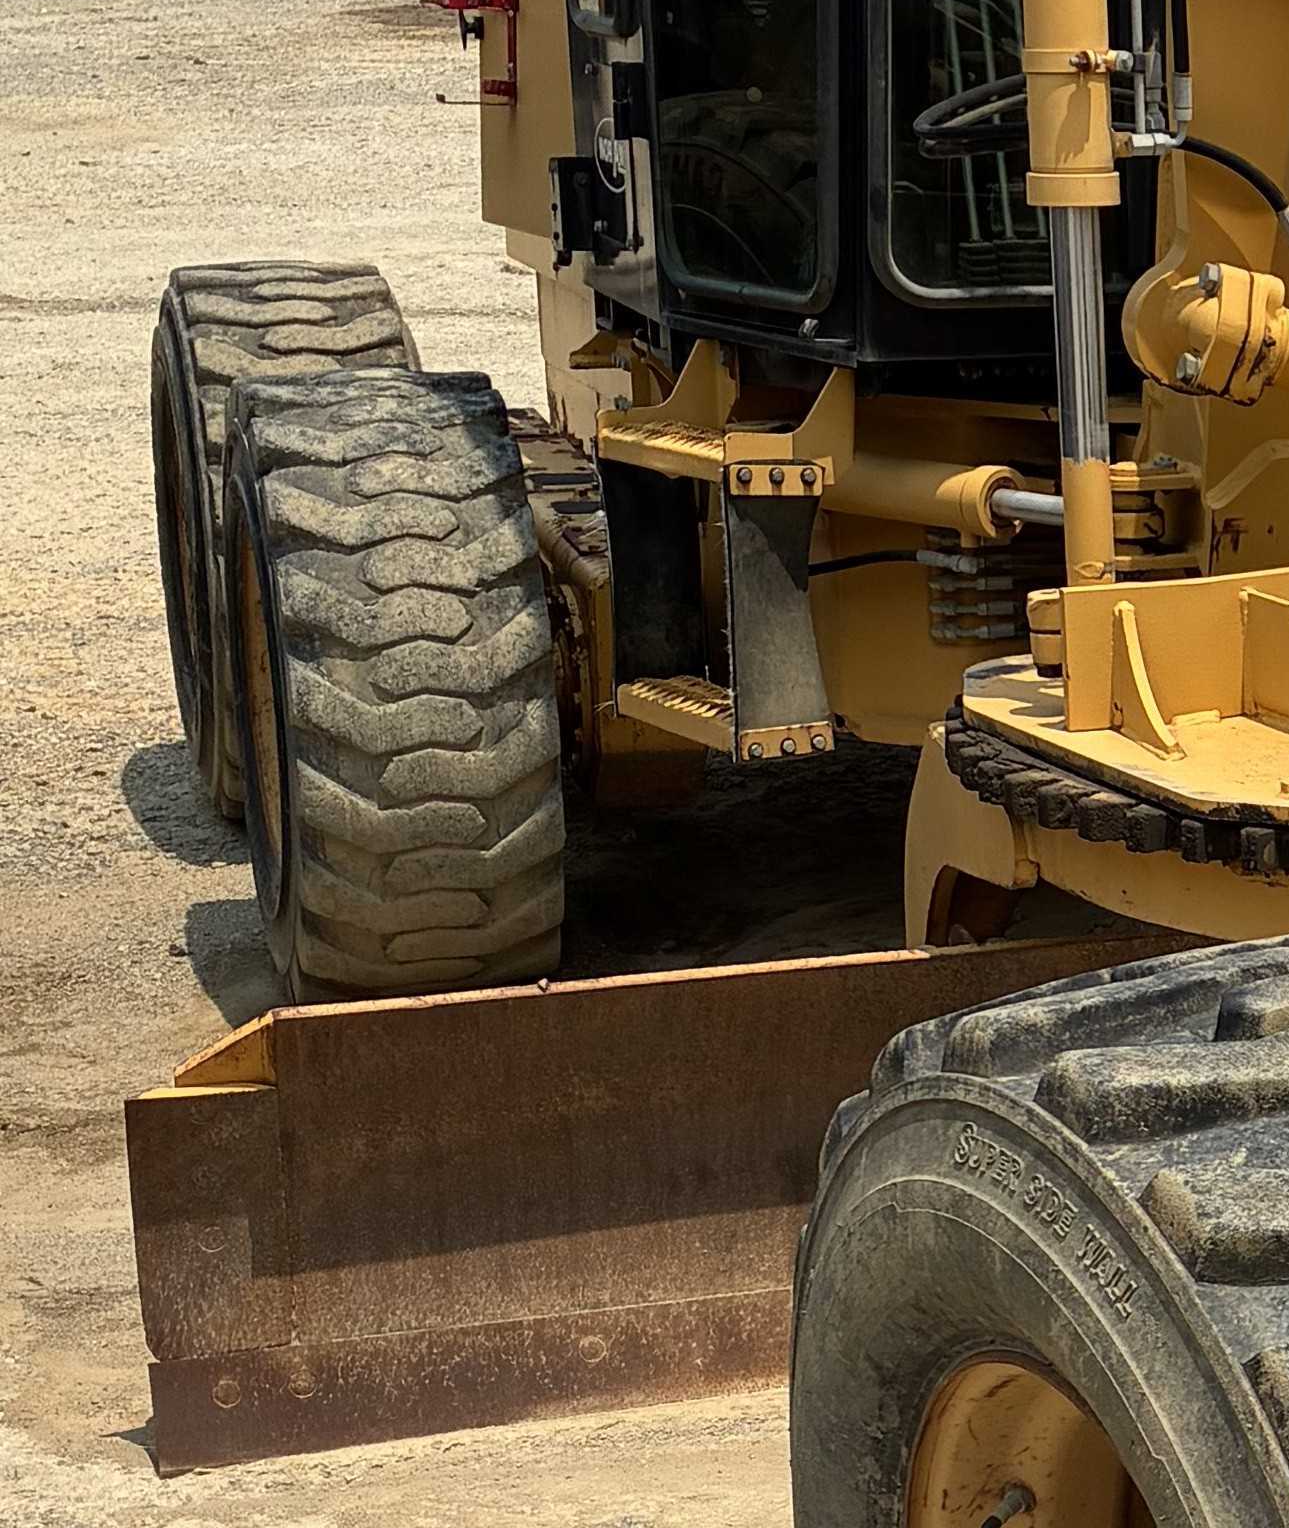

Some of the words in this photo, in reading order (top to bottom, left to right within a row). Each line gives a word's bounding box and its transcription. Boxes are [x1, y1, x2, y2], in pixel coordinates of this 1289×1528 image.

[954, 1122, 1024, 1196] SUPER
[1024, 1174, 1078, 1241] SIDE
[1077, 1224, 1139, 1318] WALL
